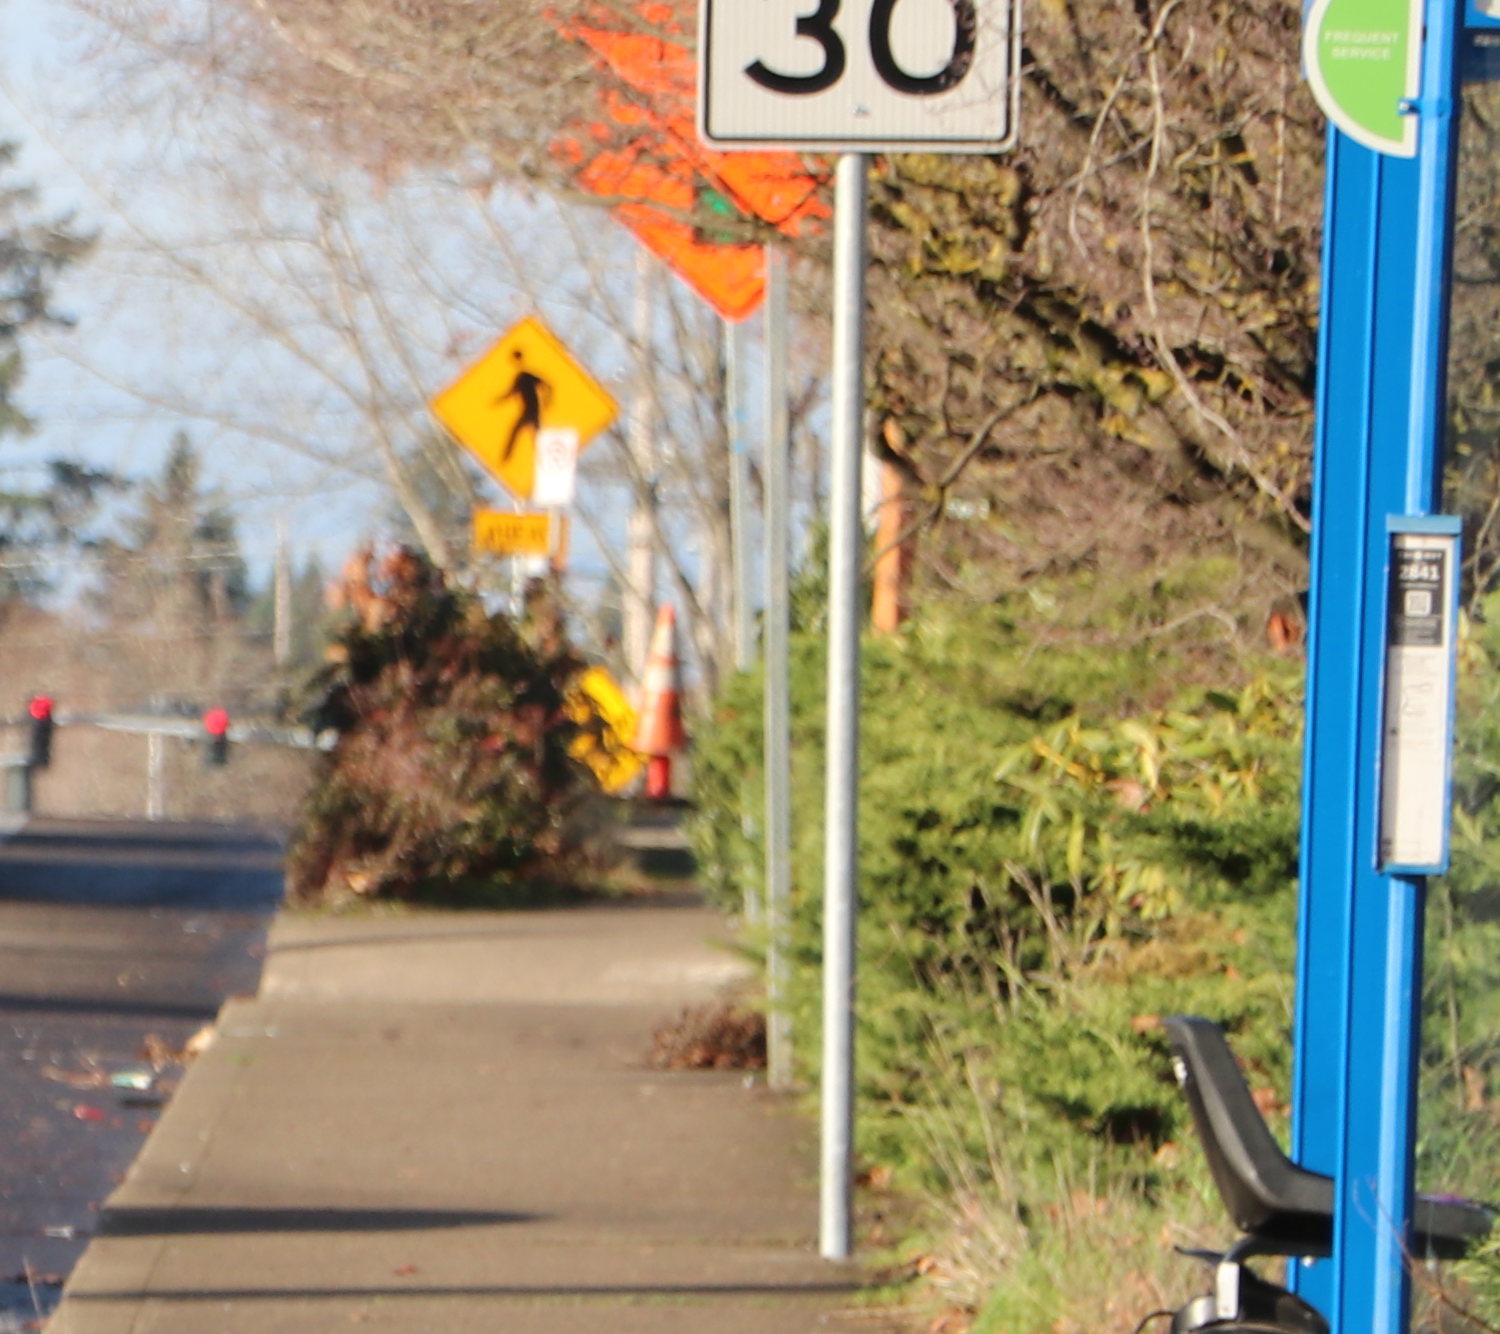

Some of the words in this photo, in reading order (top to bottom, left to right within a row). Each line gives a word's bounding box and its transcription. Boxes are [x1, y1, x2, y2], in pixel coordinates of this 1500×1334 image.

[1324, 29, 1399, 44] FREQUENT
[1331, 46, 1391, 60] SERVICE
[1398, 563, 1440, 581] 2841
